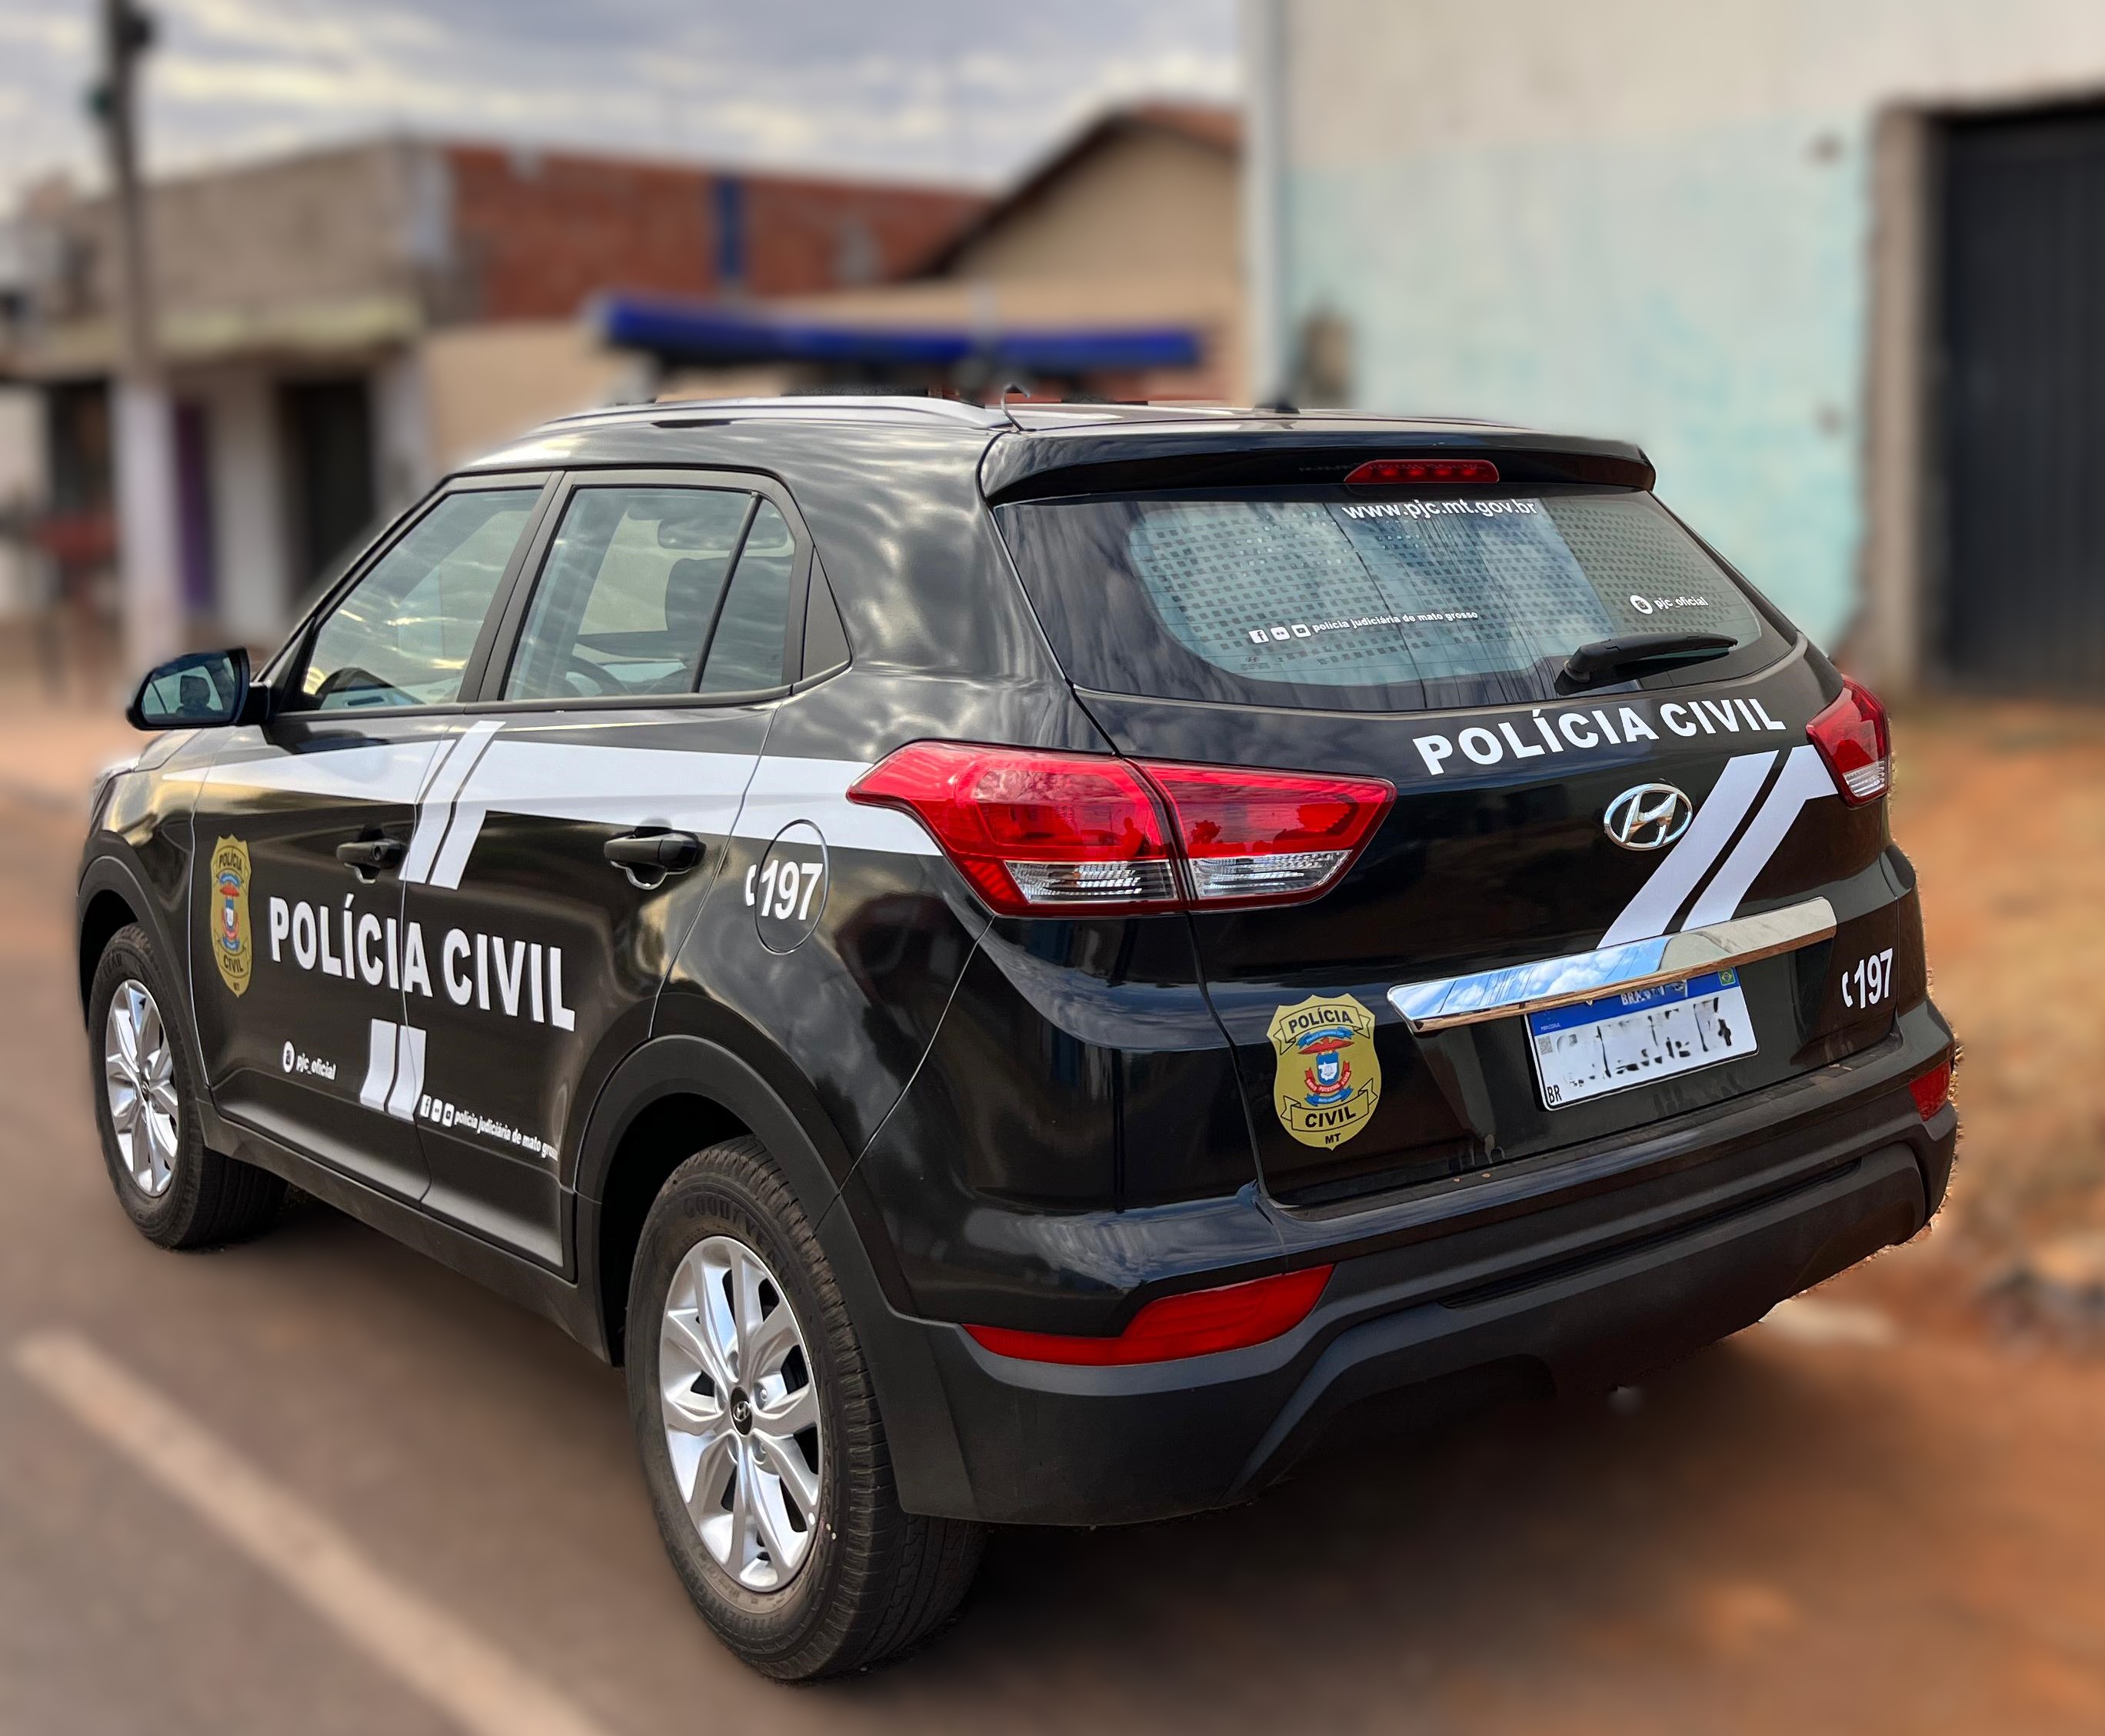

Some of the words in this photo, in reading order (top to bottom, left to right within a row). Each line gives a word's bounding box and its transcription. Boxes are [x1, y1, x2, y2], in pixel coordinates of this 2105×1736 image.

[1342, 498, 1537, 519] www.pjc.mt.gov.br
[1653, 596, 1709, 610] pjc_oficial
[1402, 614, 1416, 622] de
[1417, 612, 1444, 621] mato
[1444, 611, 1478, 621] grosso
[1413, 708, 1660, 776] POLÍCIA
[1659, 698, 1787, 737] CIVIL
[761, 859, 824, 921] 197
[224, 955, 244, 973] CIVIL
[269, 893, 433, 998] POLÍCIA
[442, 928, 575, 1031] CIVIL
[1854, 948, 1894, 1009] 197
[1288, 1008, 1354, 1034] POLÍCIA
[1547, 1085, 1562, 1104] BR
[1305, 1106, 1356, 1128] CIVIL
[511, 1128, 522, 1145] de
[522, 1135, 541, 1152] mato
[1325, 1133, 1341, 1145] MT
